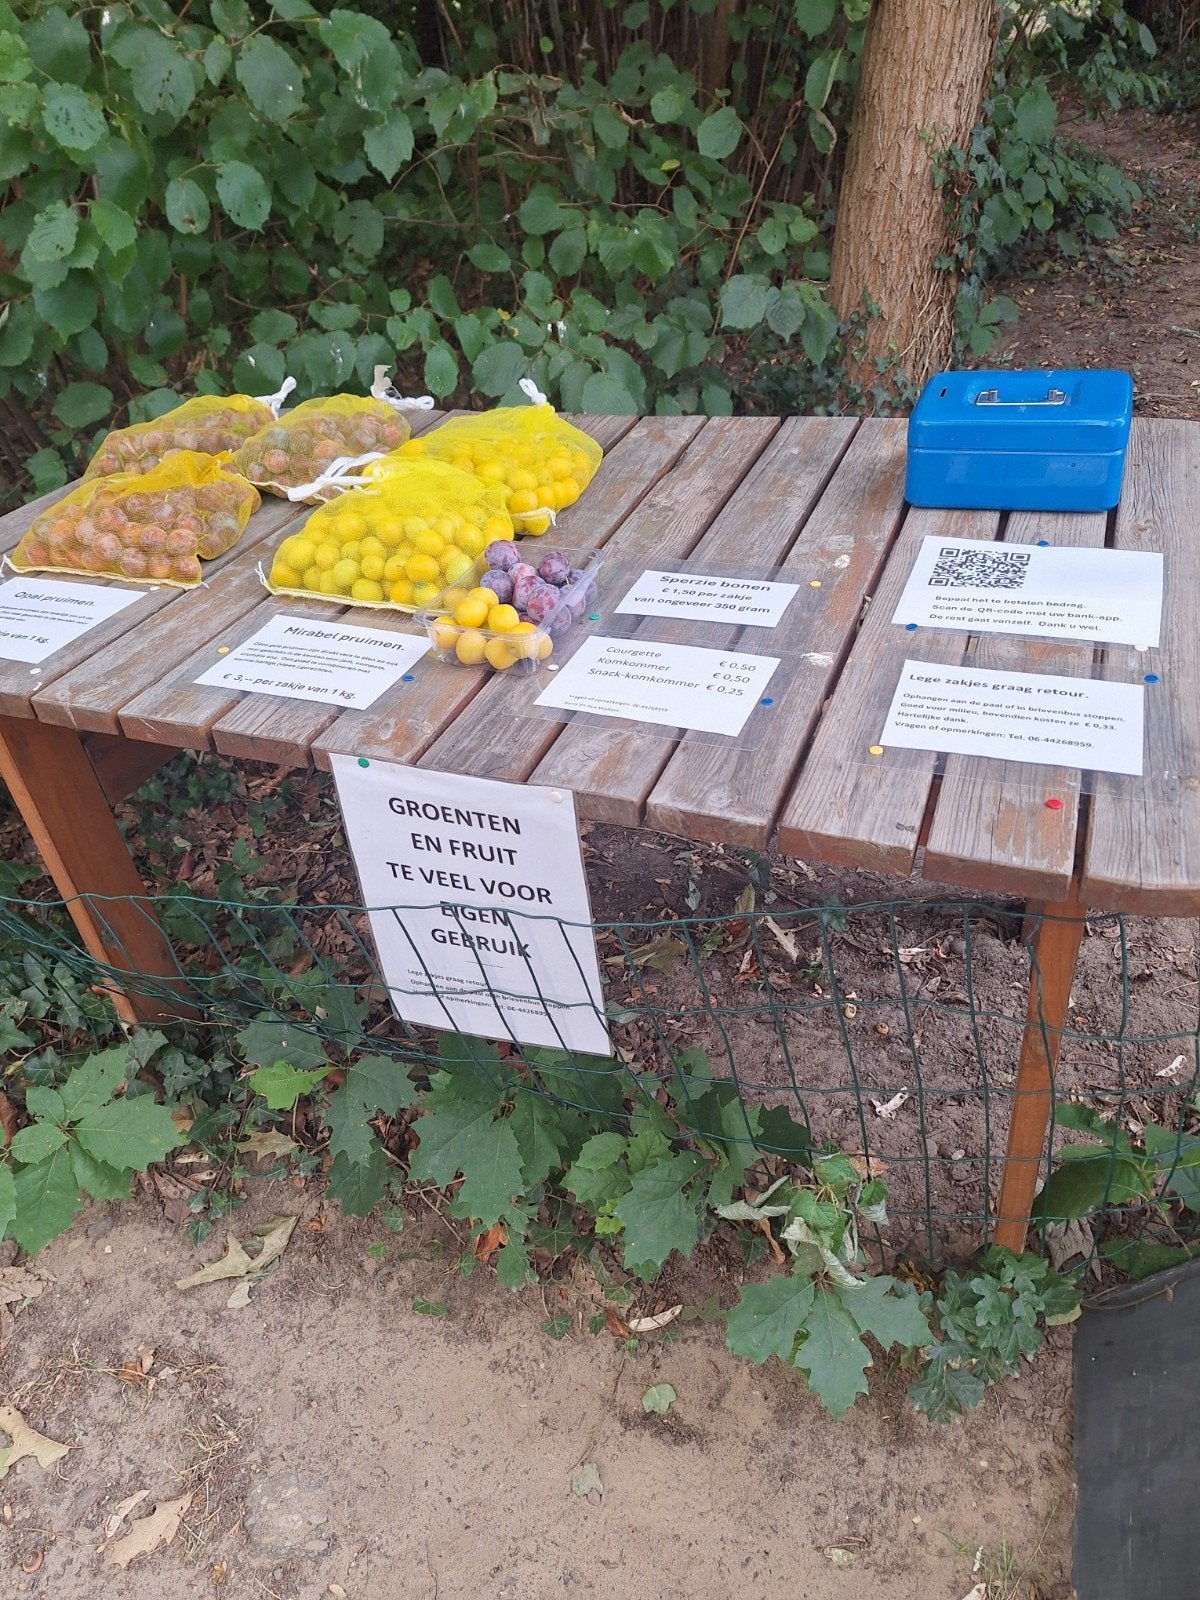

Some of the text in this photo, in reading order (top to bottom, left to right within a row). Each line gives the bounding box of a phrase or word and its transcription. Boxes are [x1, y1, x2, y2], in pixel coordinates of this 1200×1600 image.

[660, 576, 770, 591] Sperzie bonen
[673, 588, 696, 596] 1,50
[720, 593, 752, 601] zakje
[40, 596, 94, 606] pruimen.
[657, 599, 712, 607] ongeveer
[714, 602, 736, 610] 350
[935, 595, 970, 603] Bepaal
[1004, 598, 1043, 606] betalen
[1046, 601, 1085, 609] bedrag.
[978, 607, 1023, 615] QR-code
[1068, 613, 1122, 621] bank-app.
[993, 618, 1032, 626] vanzelf.
[1079, 624, 1101, 632] wel.
[284, 627, 404, 650] Mirabel pruimen.
[597, 658, 671, 671] Komkommer
[723, 674, 750, 683] 0,50
[607, 647, 756, 671] Courgette € 0,50
[223, 672, 232, 680] €
[252, 678, 274, 686] per
[275, 682, 305, 690] zakje
[339, 690, 355, 699] kg.
[588, 668, 700, 688] Snack-komkommer
[717, 686, 744, 696] 0,25
[910, 674, 1088, 698] Lege zakjes graag retour.
[897, 711, 968, 724] Hartelijke dank.
[903, 693, 948, 702] Ophangen
[1028, 706, 1080, 716] brievenbus
[1084, 714, 1125, 722] stoppen.
[895, 721, 926, 729] Vragen
[941, 727, 1005, 737] opmerkingen:
[983, 711, 1031, 720] bovendien
[1093, 723, 1116, 731] 0,33.
[389, 797, 521, 835] GROENTEN
[411, 833, 517, 865] EN FRUIT
[386, 862, 553, 904] TE VEEL VOOR
[440, 901, 509, 927] EIGEN
[430, 928, 532, 959] GEBRUIK
